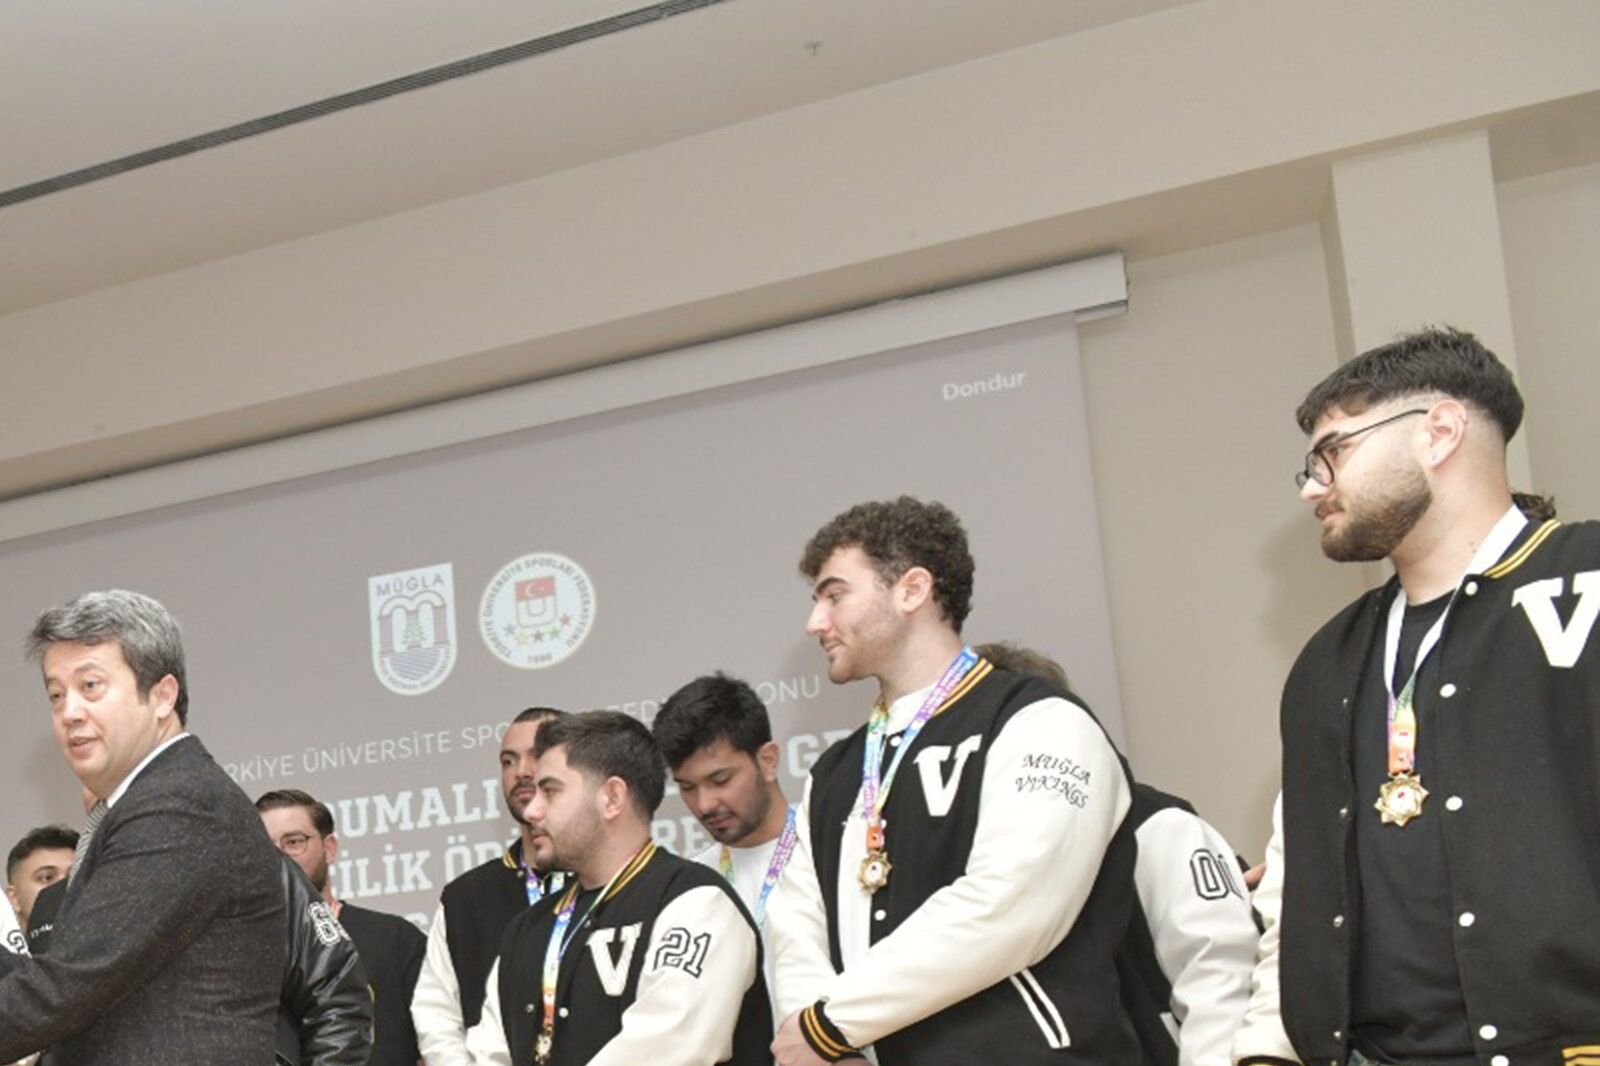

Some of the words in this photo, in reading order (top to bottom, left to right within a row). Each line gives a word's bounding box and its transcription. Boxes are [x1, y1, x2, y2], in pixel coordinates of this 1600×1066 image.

[943, 371, 1026, 400] Dondur
[1511, 569, 1600, 669] V
[223, 754, 297, 783] RKİYE
[302, 730, 451, 774] ÜNİVERSİTE
[460, 721, 511, 749] SPO
[913, 734, 983, 817] V
[585, 921, 644, 997] V
[652, 926, 712, 979] 21
